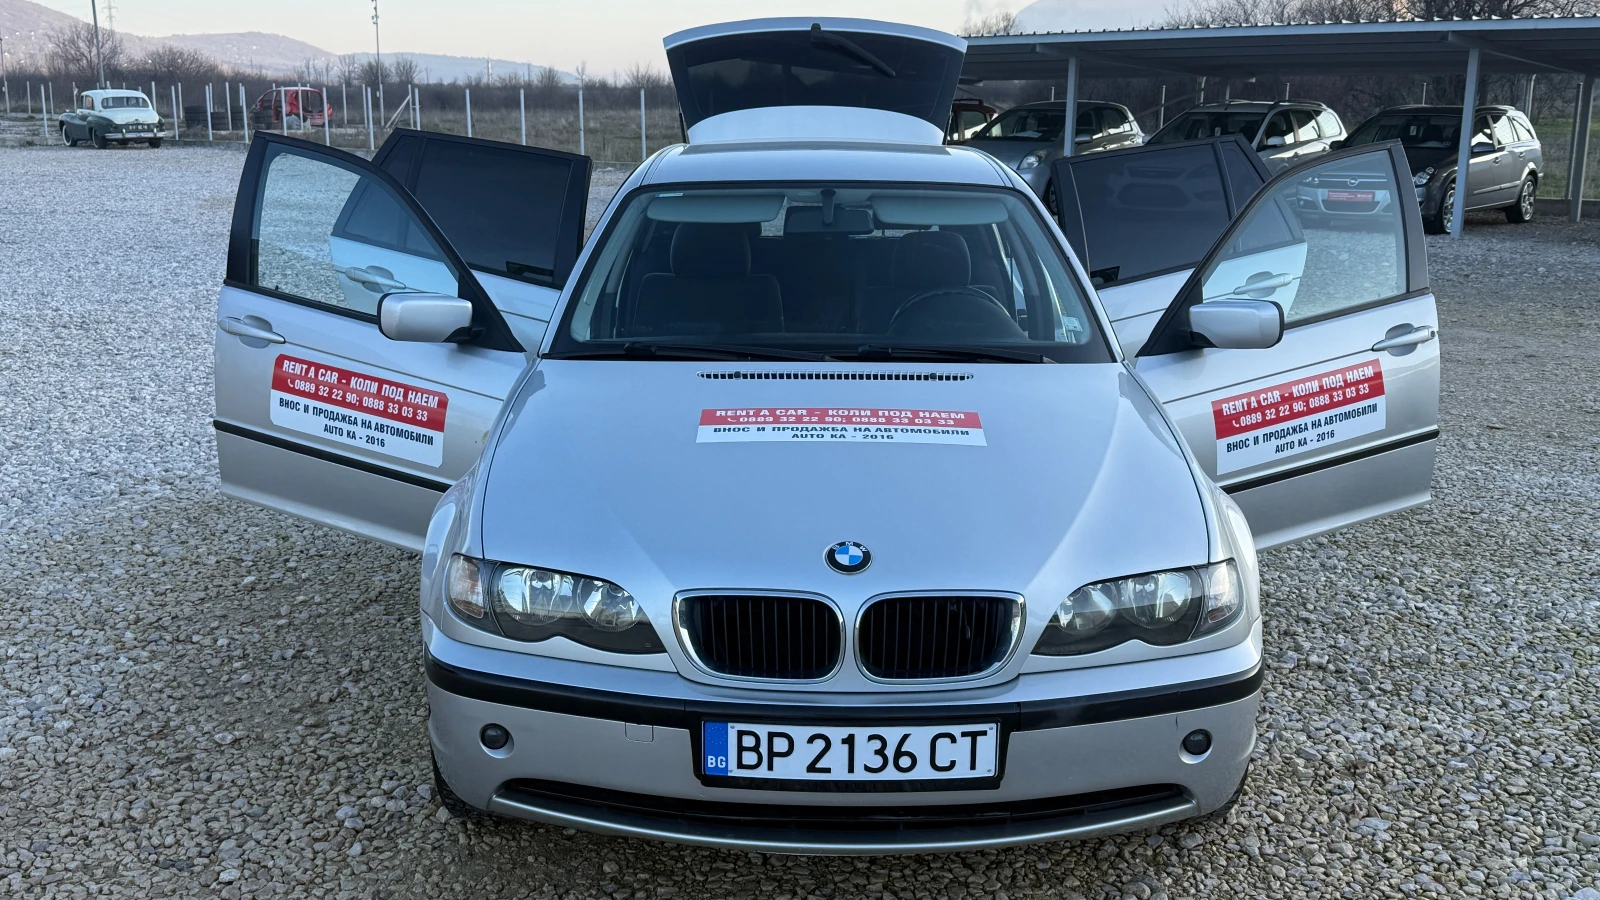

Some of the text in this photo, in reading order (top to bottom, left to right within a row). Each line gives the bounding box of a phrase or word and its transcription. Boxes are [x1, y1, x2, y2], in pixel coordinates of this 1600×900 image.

[283, 360, 308, 375] RENT
[308, 367, 315, 378] A
[318, 369, 338, 384] CAR
[350, 376, 378, 394] КОЛИ
[382, 384, 404, 403] ПОД
[408, 391, 439, 409] НАЕМ
[294, 381, 428, 421] 0889 32 22 90; 0888 33 03 33
[1222, 401, 1249, 416] RENT
[1250, 396, 1258, 408] A
[1260, 391, 1281, 406] CAR
[1292, 382, 1320, 398] КОЛИ
[1322, 374, 1344, 389] ПОД
[1346, 365, 1374, 383] НАЕМ
[1240, 384, 1369, 427] 0889 32 22 90; 0888 33 03 33
[279, 398, 434, 445] ВНОС И ПРОДАЖБА НА АВТОМОБИЛИ
[324, 424, 343, 436] AUTO
[366, 435, 385, 447] 2016
[1226, 403, 1377, 453] ВНОС И ПРОДАЖБА НА АВТОМОБИЛИ
[1275, 440, 1295, 454] AUTO
[1317, 430, 1335, 442] 2016
[832, 542, 868, 551] BMW
[708, 756, 726, 768] BG
[736, 730, 988, 774] BP 2136 CT
